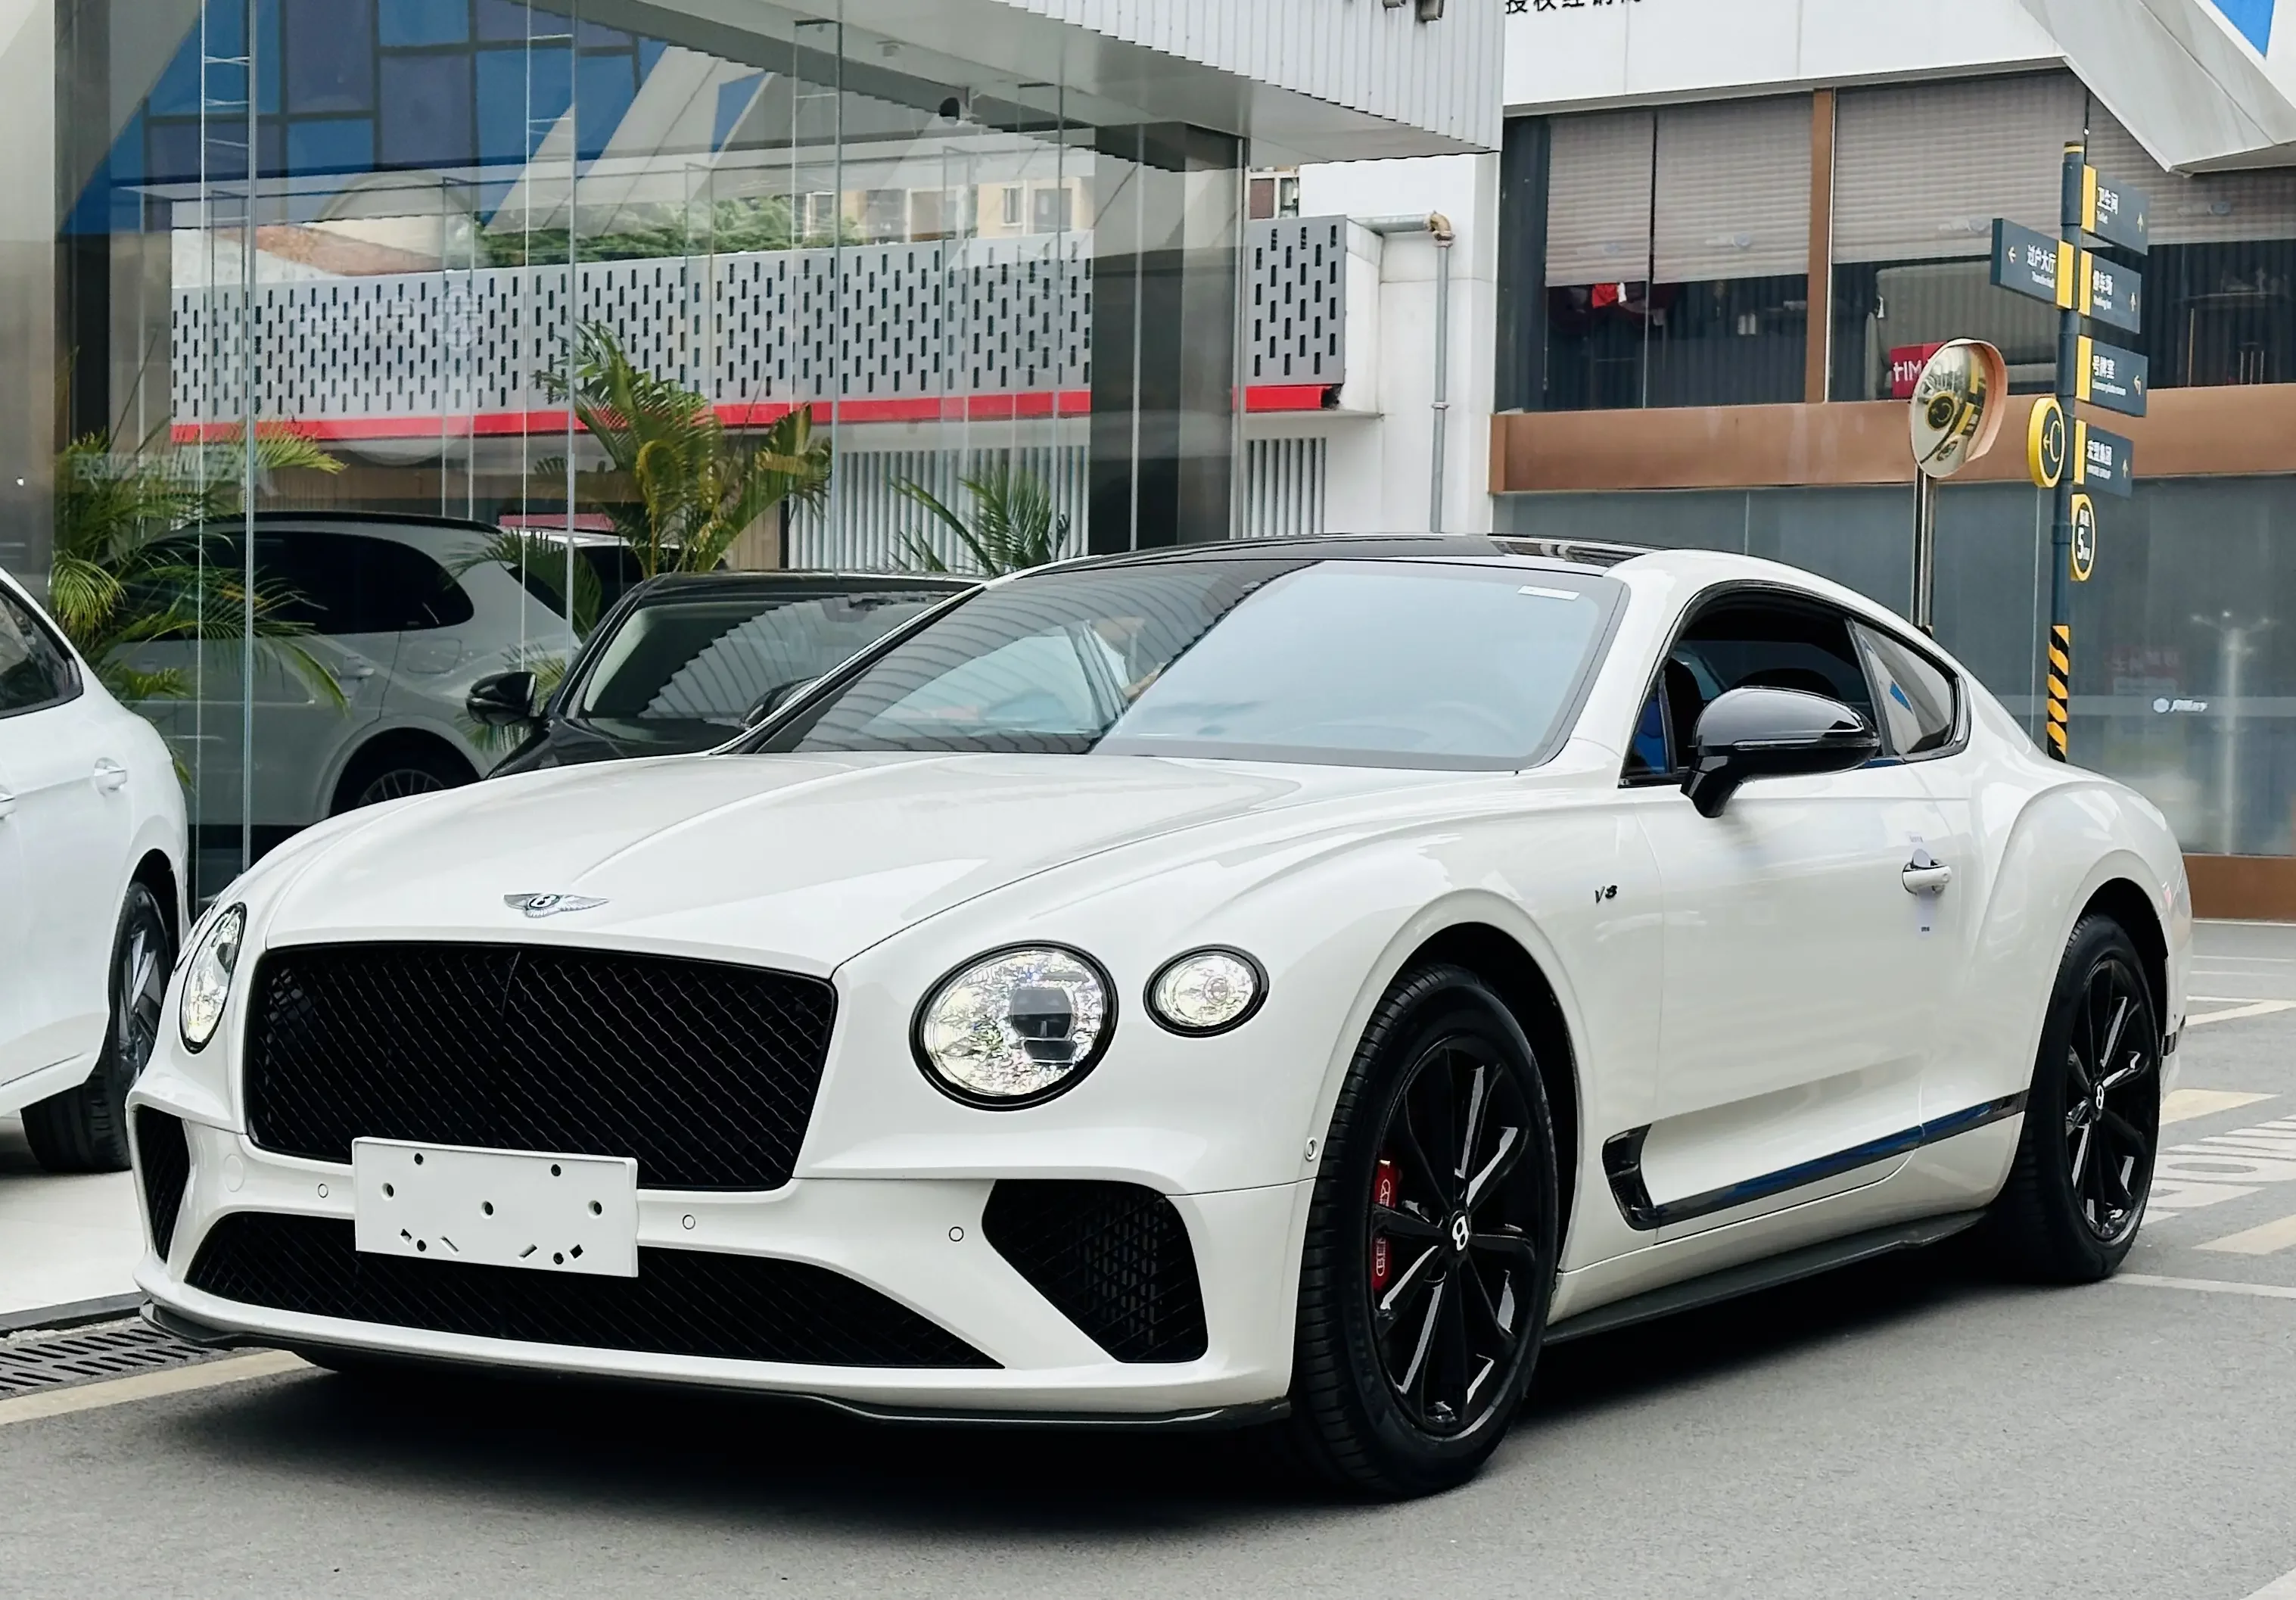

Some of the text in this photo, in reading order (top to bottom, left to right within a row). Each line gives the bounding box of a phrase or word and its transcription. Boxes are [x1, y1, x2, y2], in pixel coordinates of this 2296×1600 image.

[2097, 186, 2119, 216] 卫生间
[2027, 244, 2057, 274] 过户大厅
[2077, 527, 2084, 560] 5
[1594, 885, 1618, 904] V8
